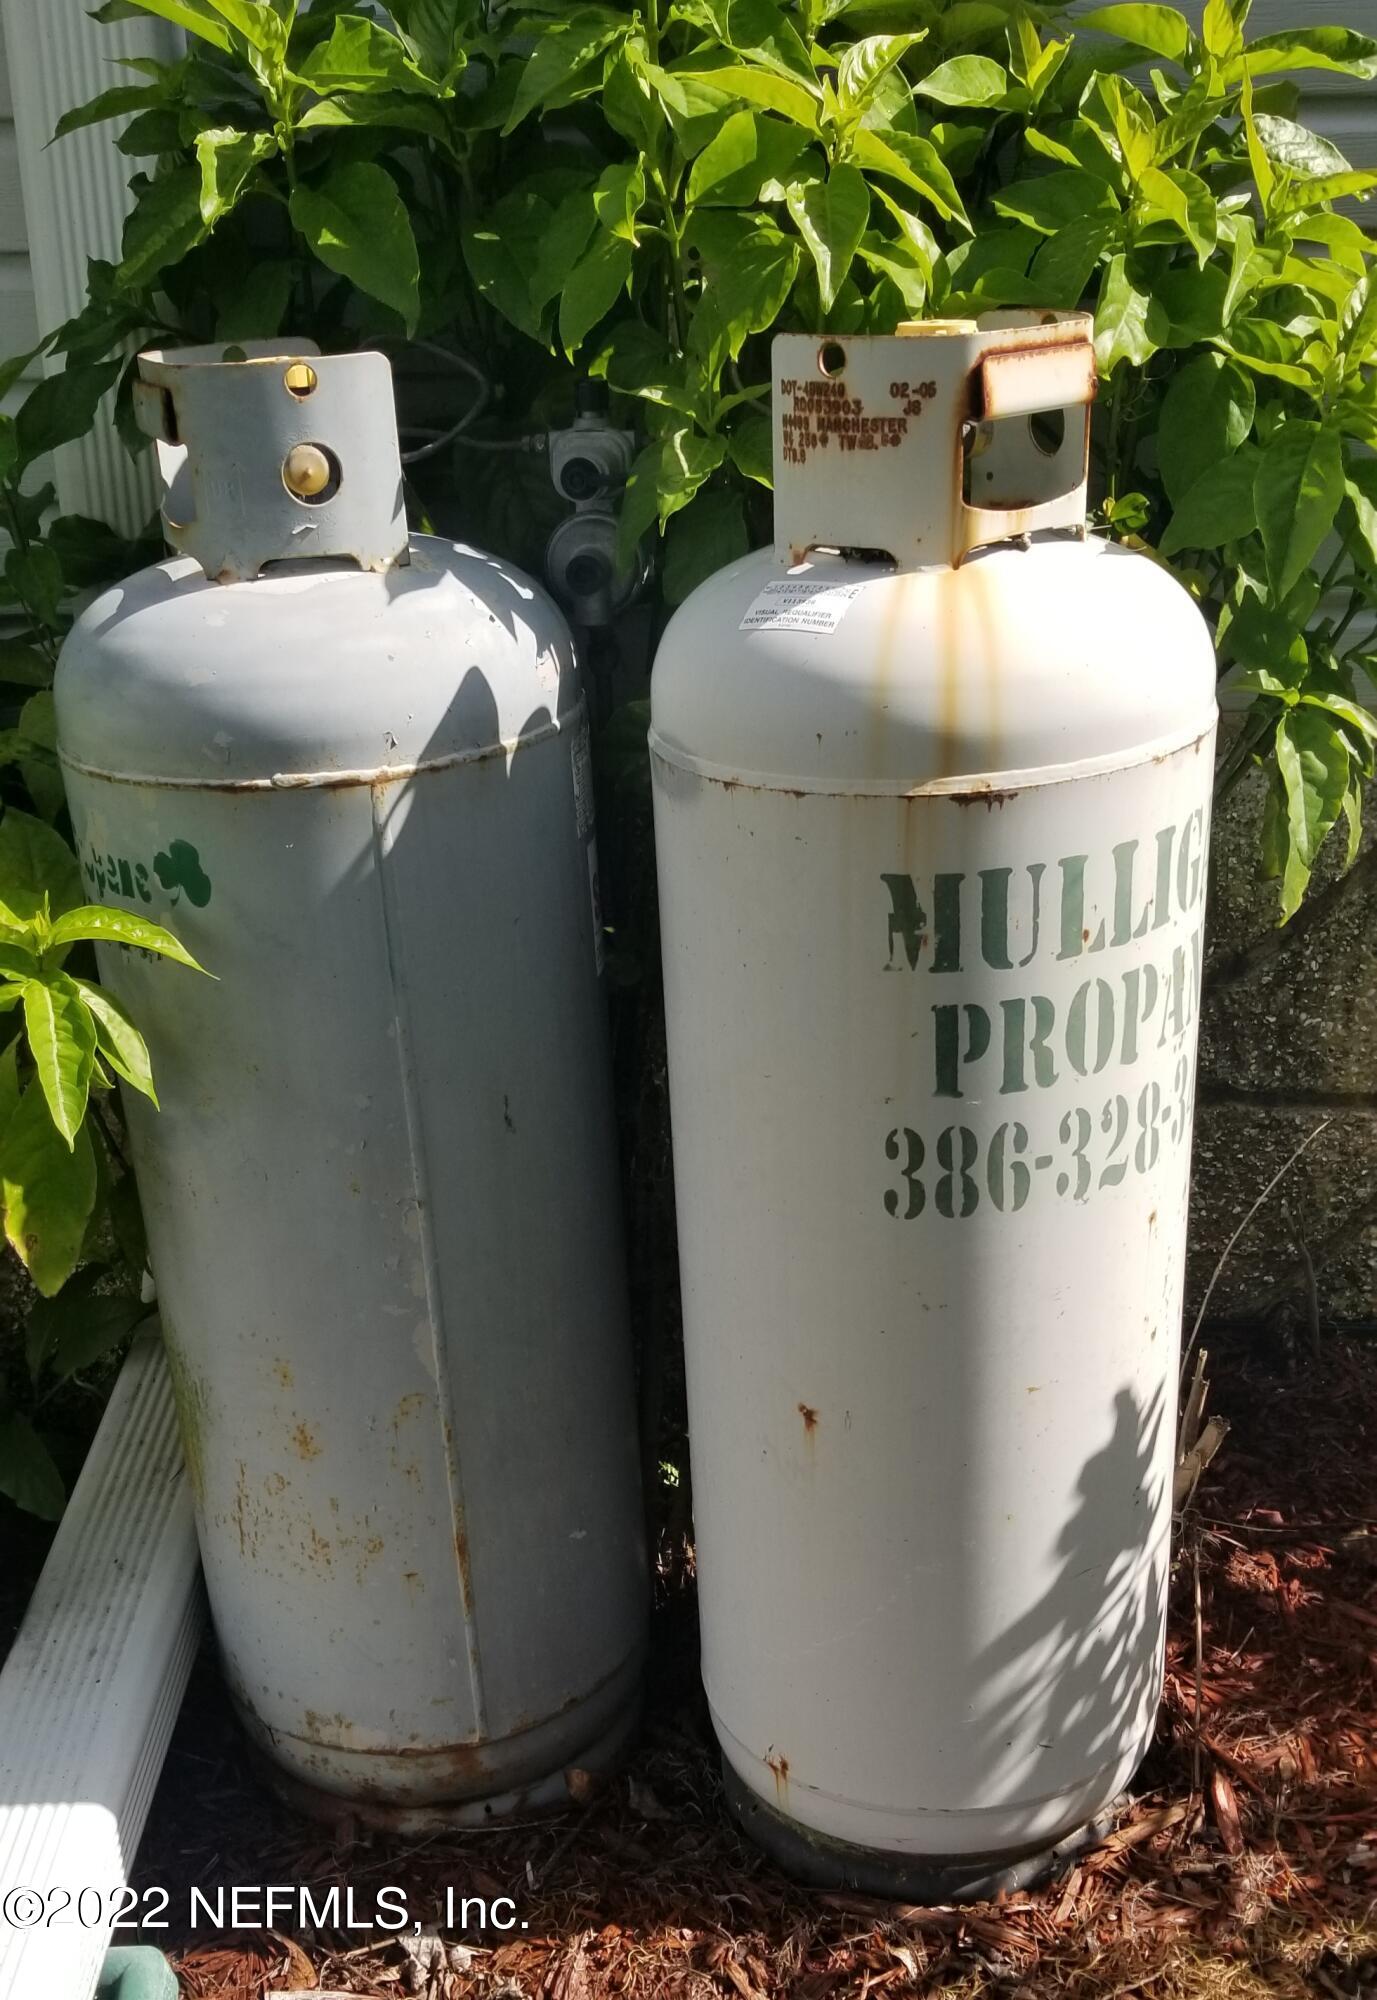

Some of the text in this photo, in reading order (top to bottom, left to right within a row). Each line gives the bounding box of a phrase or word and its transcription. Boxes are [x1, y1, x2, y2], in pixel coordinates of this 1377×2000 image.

[817, 416, 908, 434] MANCHESTER
[782, 609, 832, 619] REQUALIFIER
[744, 616, 799, 624] IDENTIFICATION
[802, 618, 836, 629] NUMBER
